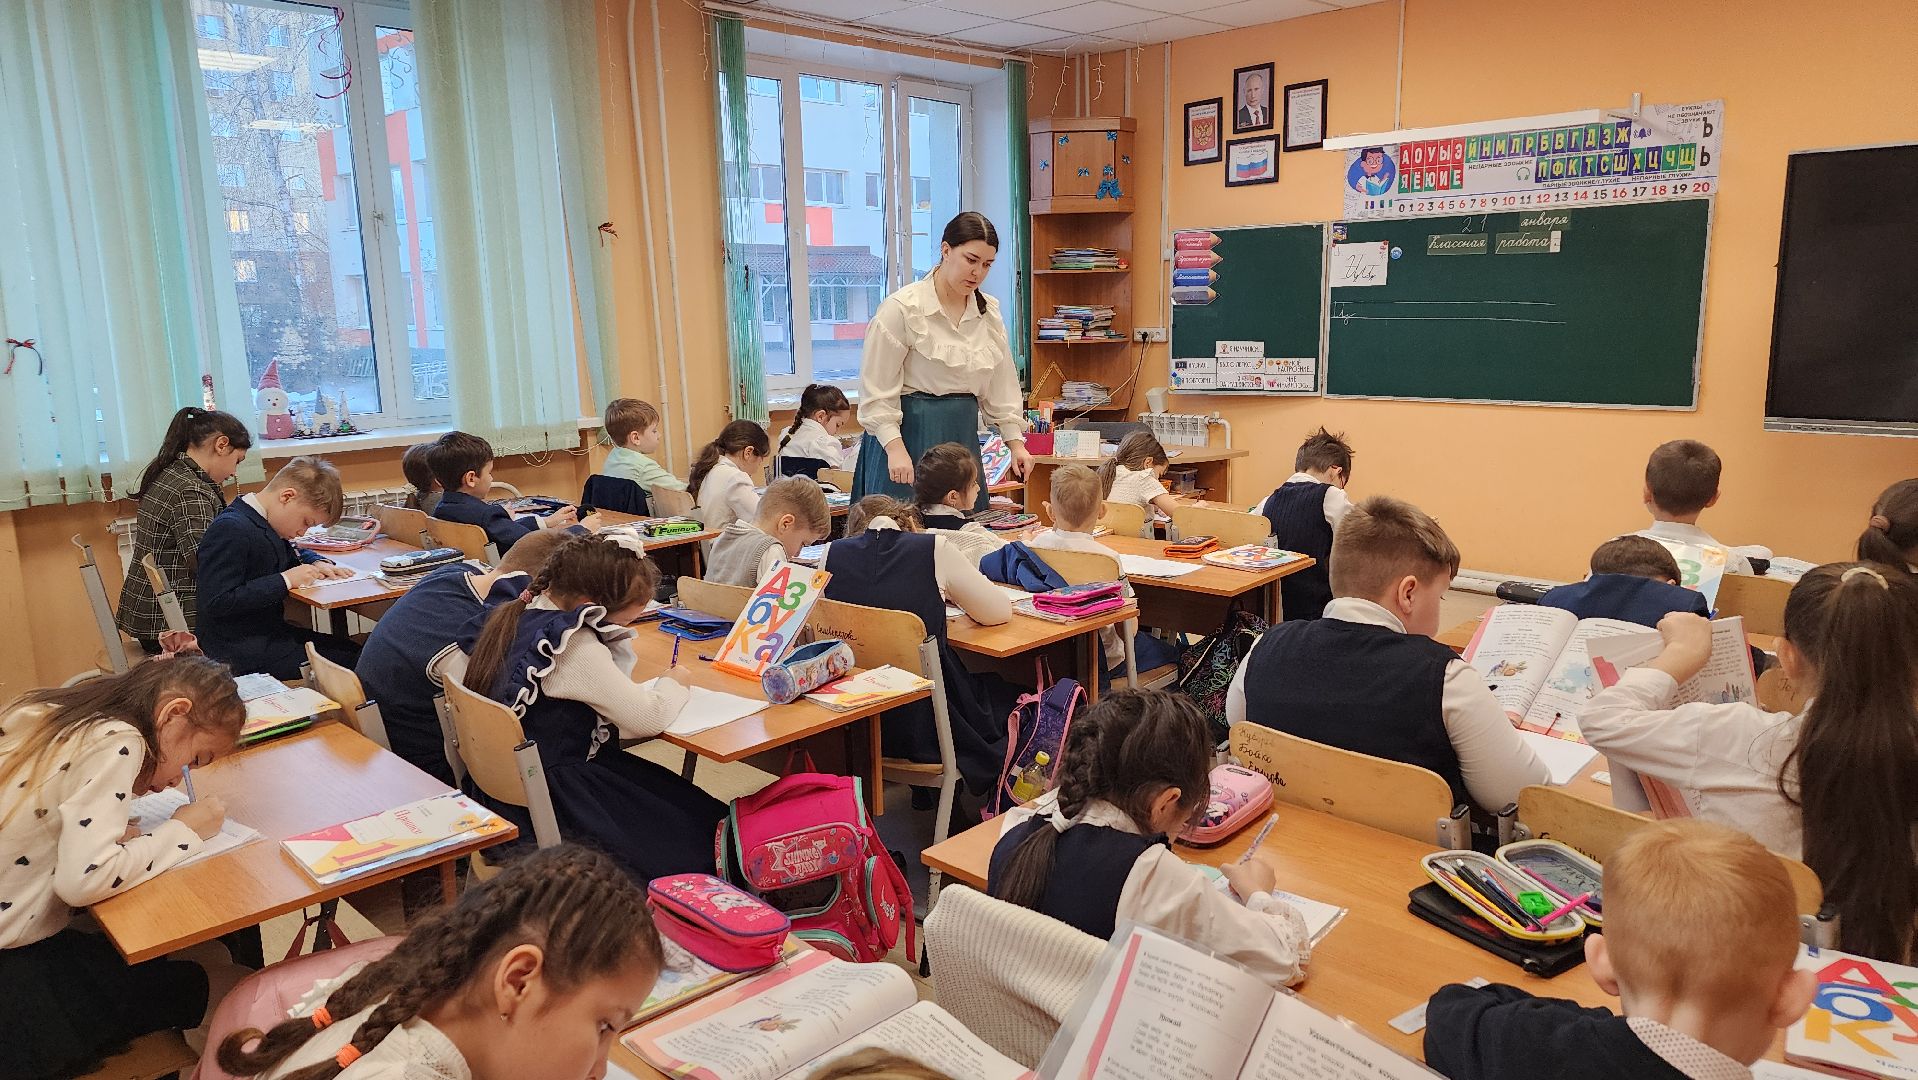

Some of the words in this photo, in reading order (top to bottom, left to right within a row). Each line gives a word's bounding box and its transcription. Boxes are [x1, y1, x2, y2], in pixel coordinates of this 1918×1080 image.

[1399, 203, 1405, 213] 0
[1408, 203, 1414, 211] 1
[1417, 202, 1425, 212] 2
[1427, 202, 1434, 211] 3
[1437, 201, 1445, 211] 4
[1448, 200, 1455, 210] 5
[1459, 199, 1466, 209] 6
[1470, 199, 1477, 208] 7
[1480, 198, 1487, 208] 8
[1491, 197, 1498, 207] 9
[1502, 196, 1516, 206] 10
[1520, 195, 1532, 205] 11
[1536, 193, 1551, 204] 12
[1554, 192, 1569, 202] 13
[1573, 191, 1588, 201] 14
[1593, 189, 1608, 200] 15
[1612, 188, 1627, 199] 16
[1632, 186, 1647, 197] 17
[1651, 185, 1667, 195] 18
[1672, 184, 1688, 194] 19
[1692, 182, 1710, 193] 20
[1520, 212, 1569, 230] января
[1428, 235, 1486, 250] Классная
[1496, 233, 1549, 254] работа
